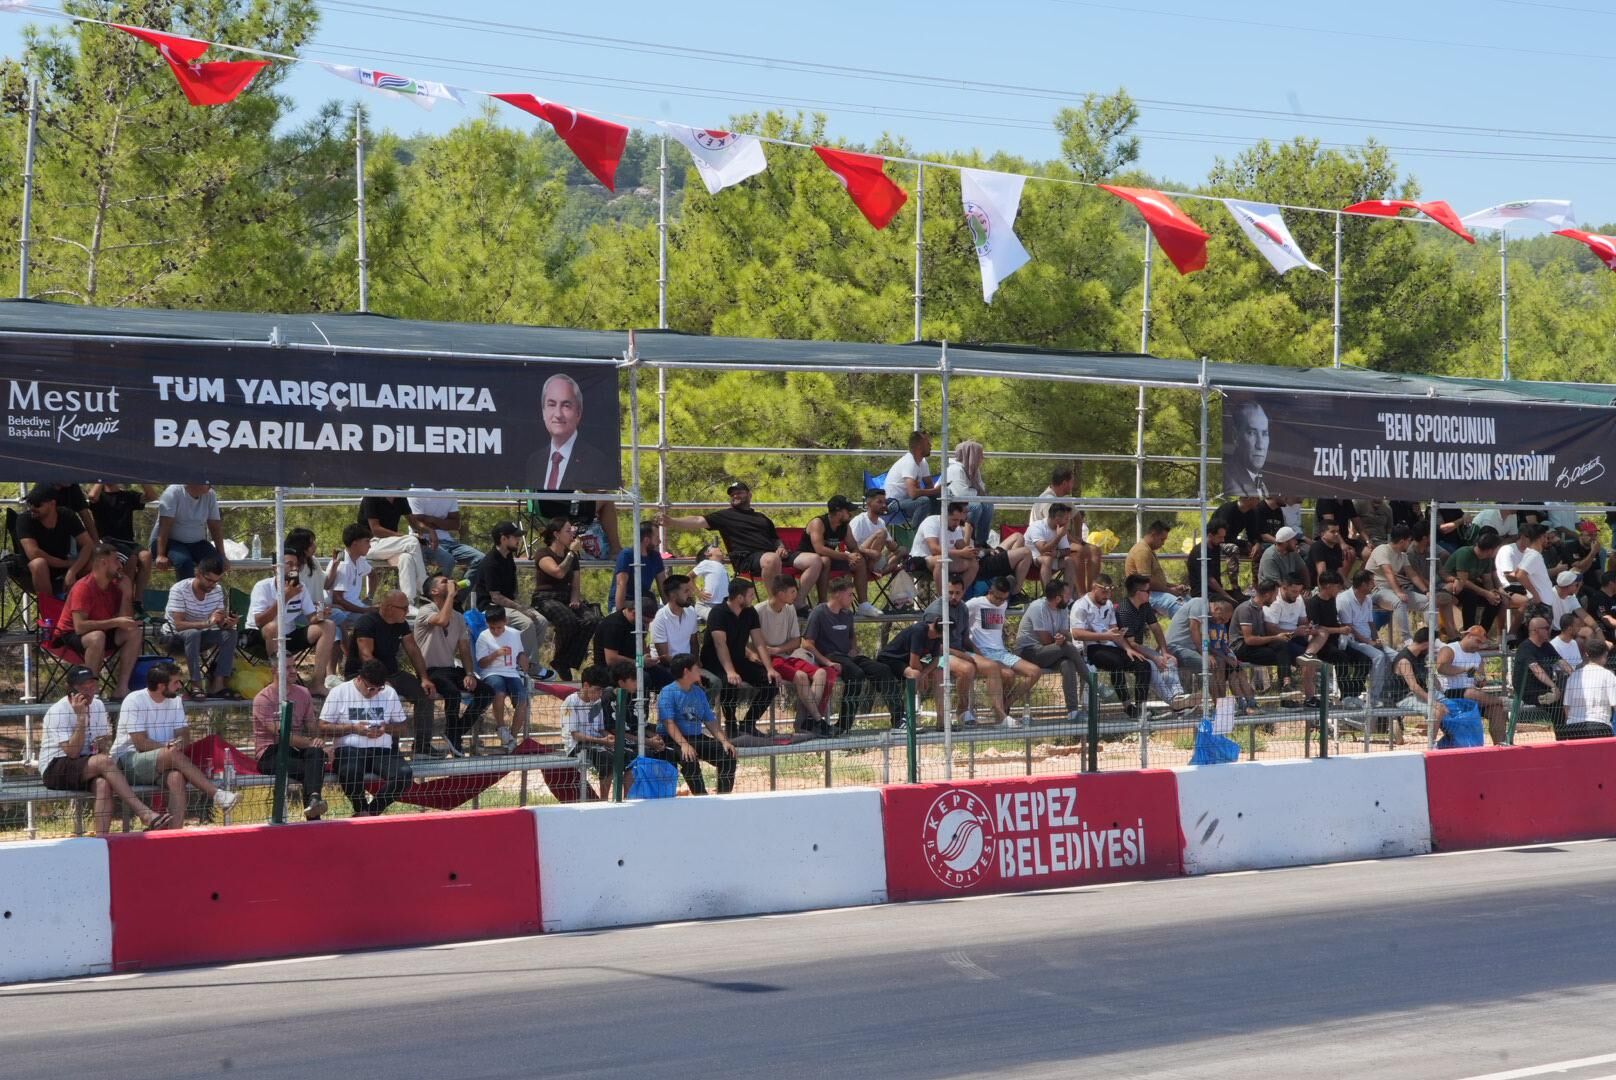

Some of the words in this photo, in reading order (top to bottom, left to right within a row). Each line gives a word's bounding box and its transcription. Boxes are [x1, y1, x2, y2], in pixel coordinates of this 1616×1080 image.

[8, 380, 119, 413] Mesut
[236, 379, 496, 413] YARIŞÇILARIMIZA
[8, 415, 51, 429] Belediye
[8, 426, 51, 440] Başkanı
[57, 414, 119, 443] Kocagöz
[154, 418, 363, 455] BAŞARILAR
[372, 424, 502, 454] DİLERİM
[1415, 414, 1496, 445] SPORCUNUN
[1313, 443, 1347, 480] ZEKİ,
[1351, 444, 1390, 483] ÇEVİK
[1393, 450, 1410, 479] VE
[1413, 451, 1492, 481] AHLAKLISINI
[928, 795, 988, 830] KEPEZ
[995, 787, 1079, 832] KEPEZ
[999, 818, 1146, 878] BELEDİYESİ
